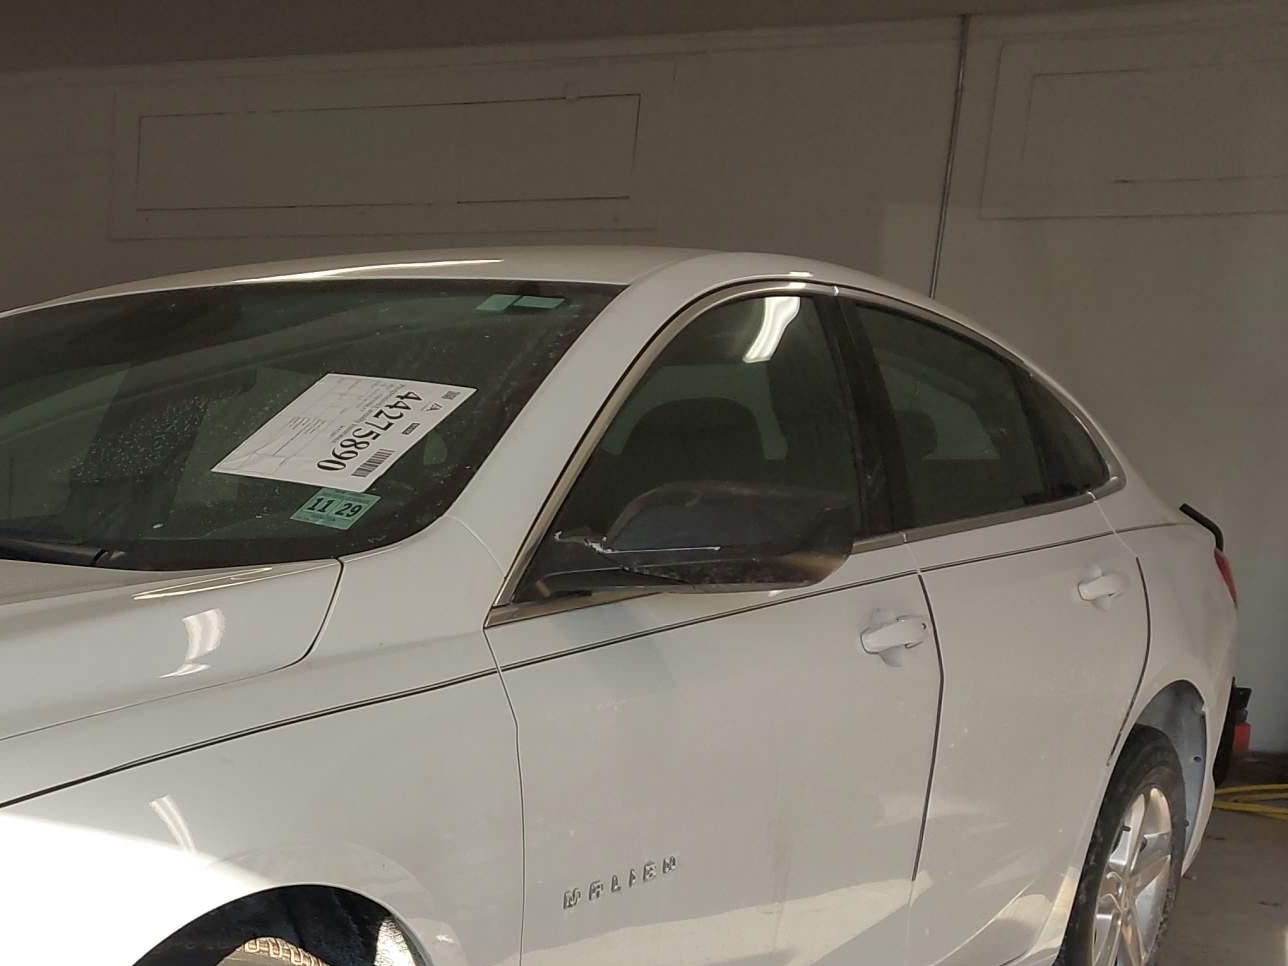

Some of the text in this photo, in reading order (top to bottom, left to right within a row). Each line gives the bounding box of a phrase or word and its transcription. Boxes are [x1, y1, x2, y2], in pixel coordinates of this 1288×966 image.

[317, 391, 423, 471] 44275890
[307, 497, 335, 513] 11
[335, 502, 363, 518] 29
